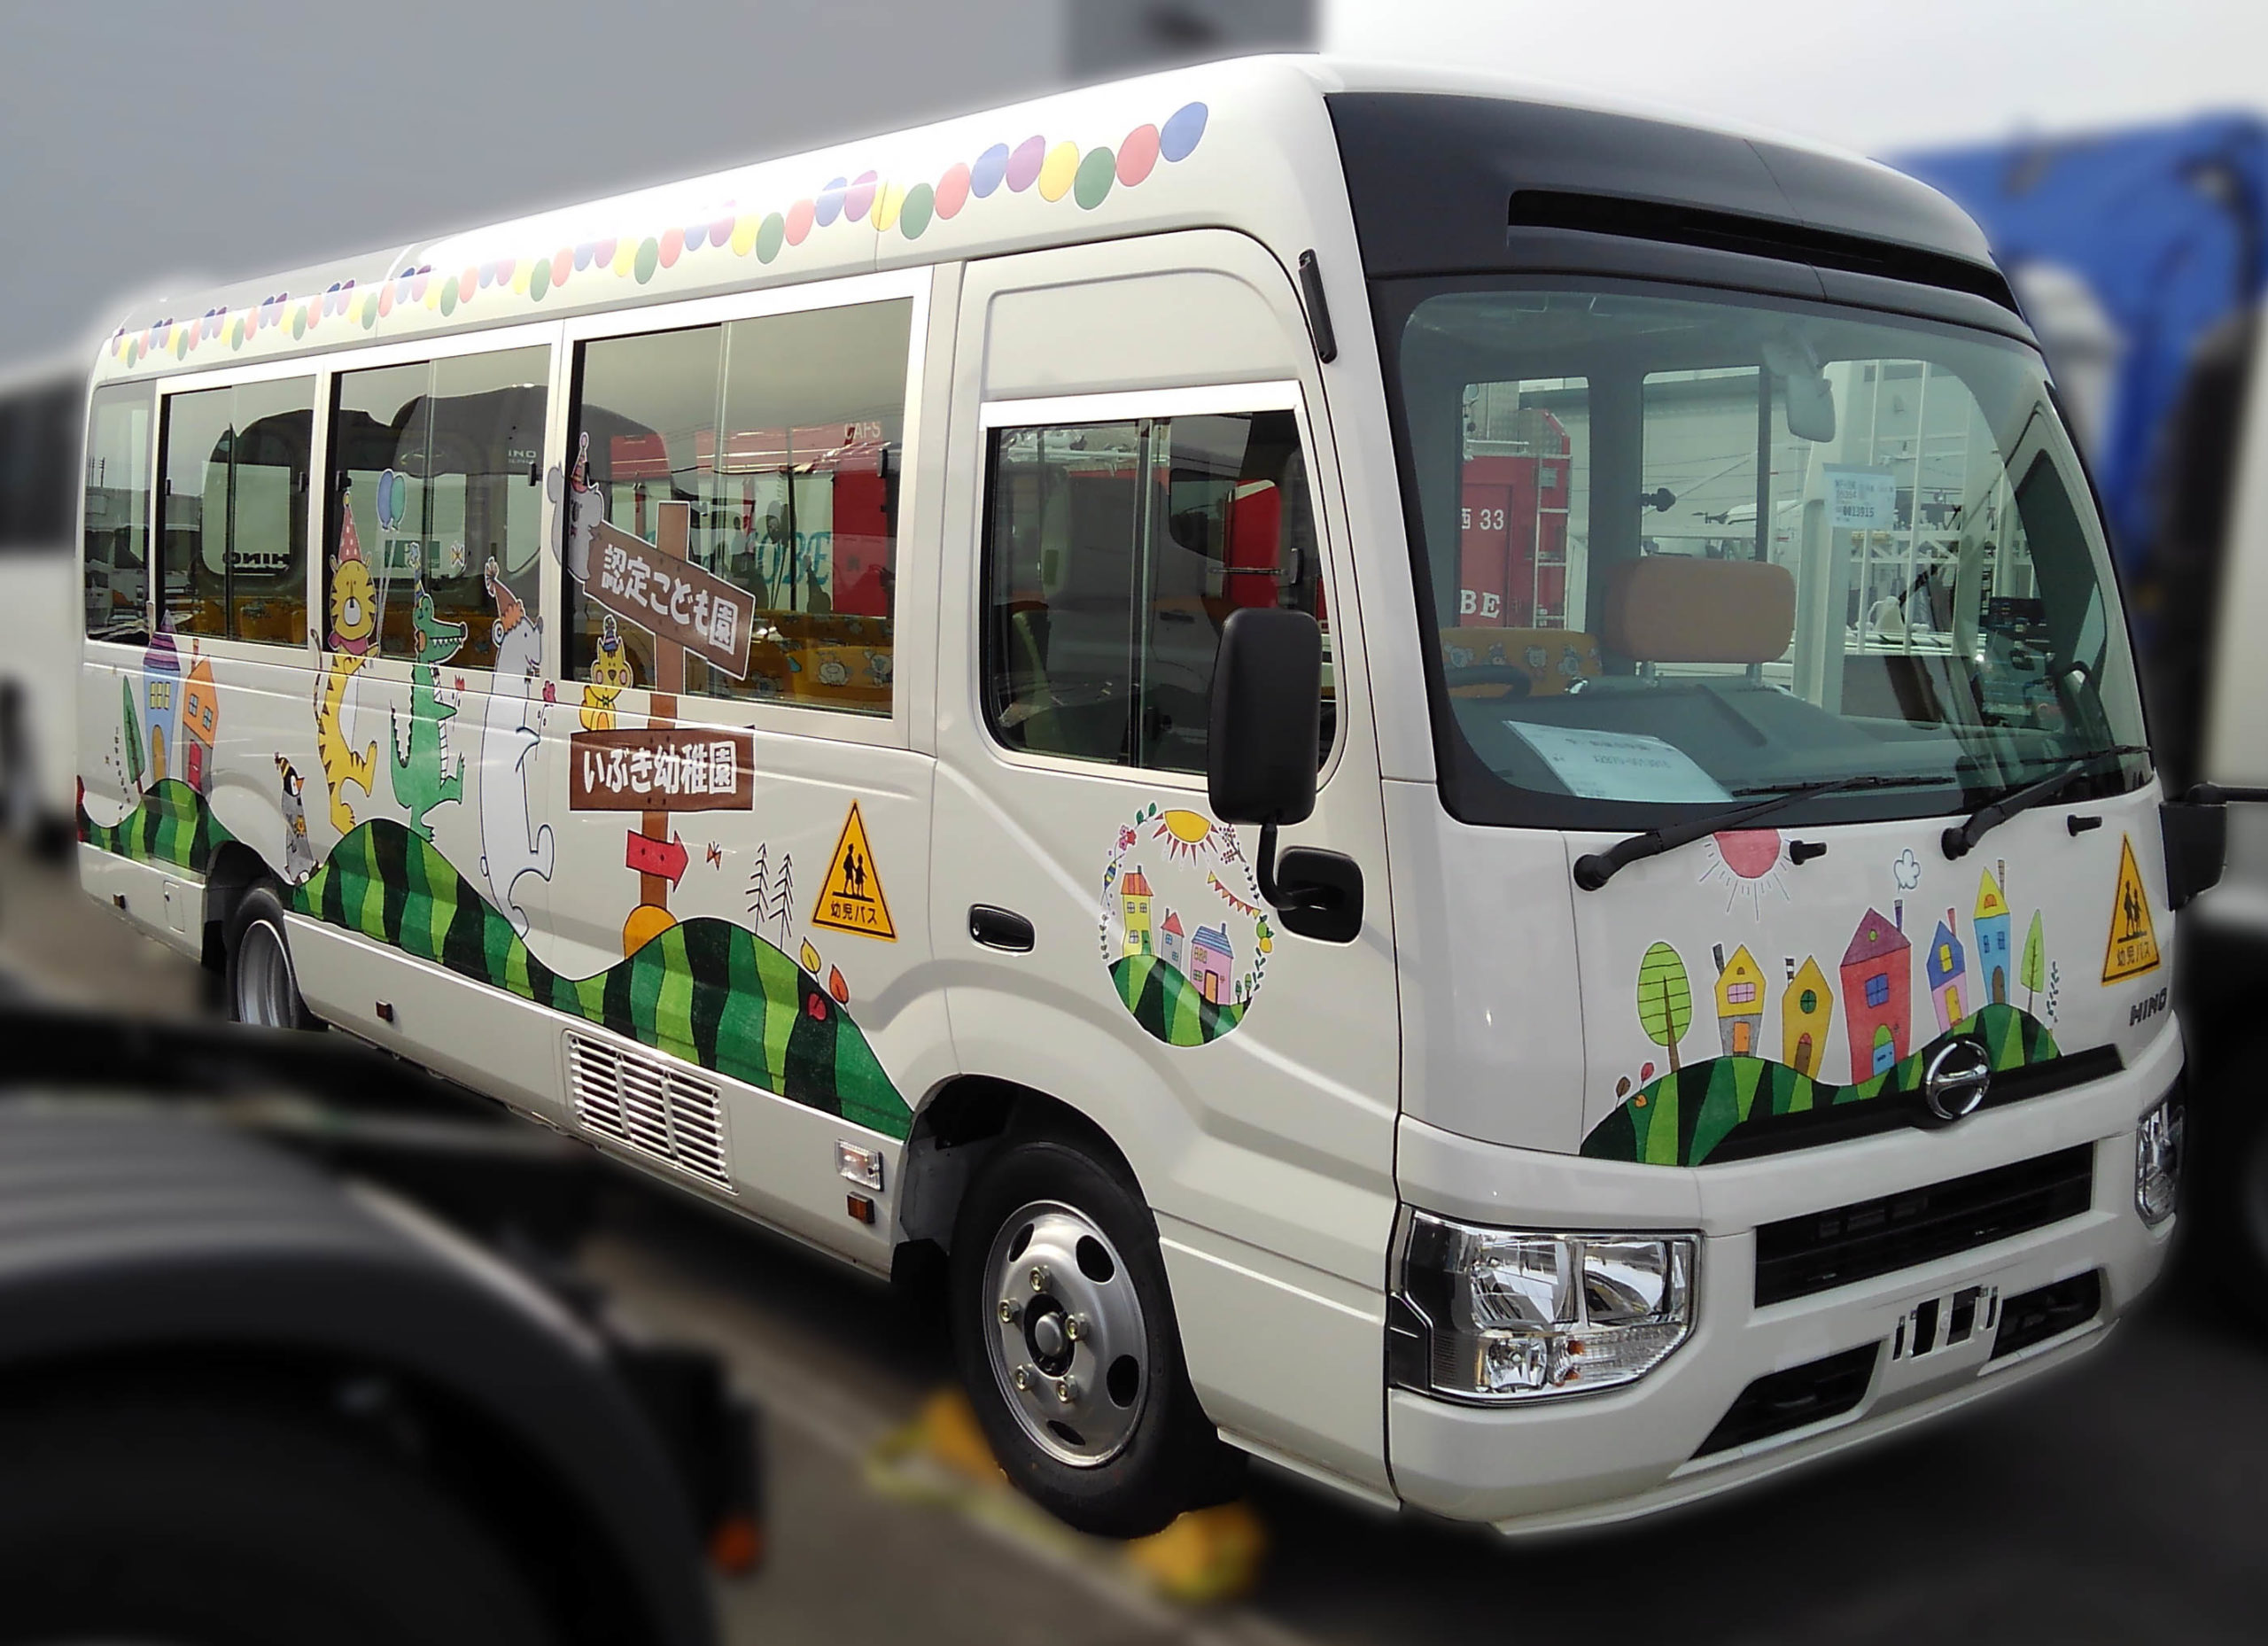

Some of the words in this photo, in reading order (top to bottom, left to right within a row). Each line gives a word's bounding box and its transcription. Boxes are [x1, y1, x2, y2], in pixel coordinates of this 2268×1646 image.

[1480, 509, 1504, 531] 33
[601, 543, 739, 656] 認定こども園
[583, 741, 737, 795] いぶき幼稚園
[830, 900, 879, 925] 幼児バス
[2117, 941, 2151, 967] 幼児バス
[2129, 987, 2168, 1027] HINO
